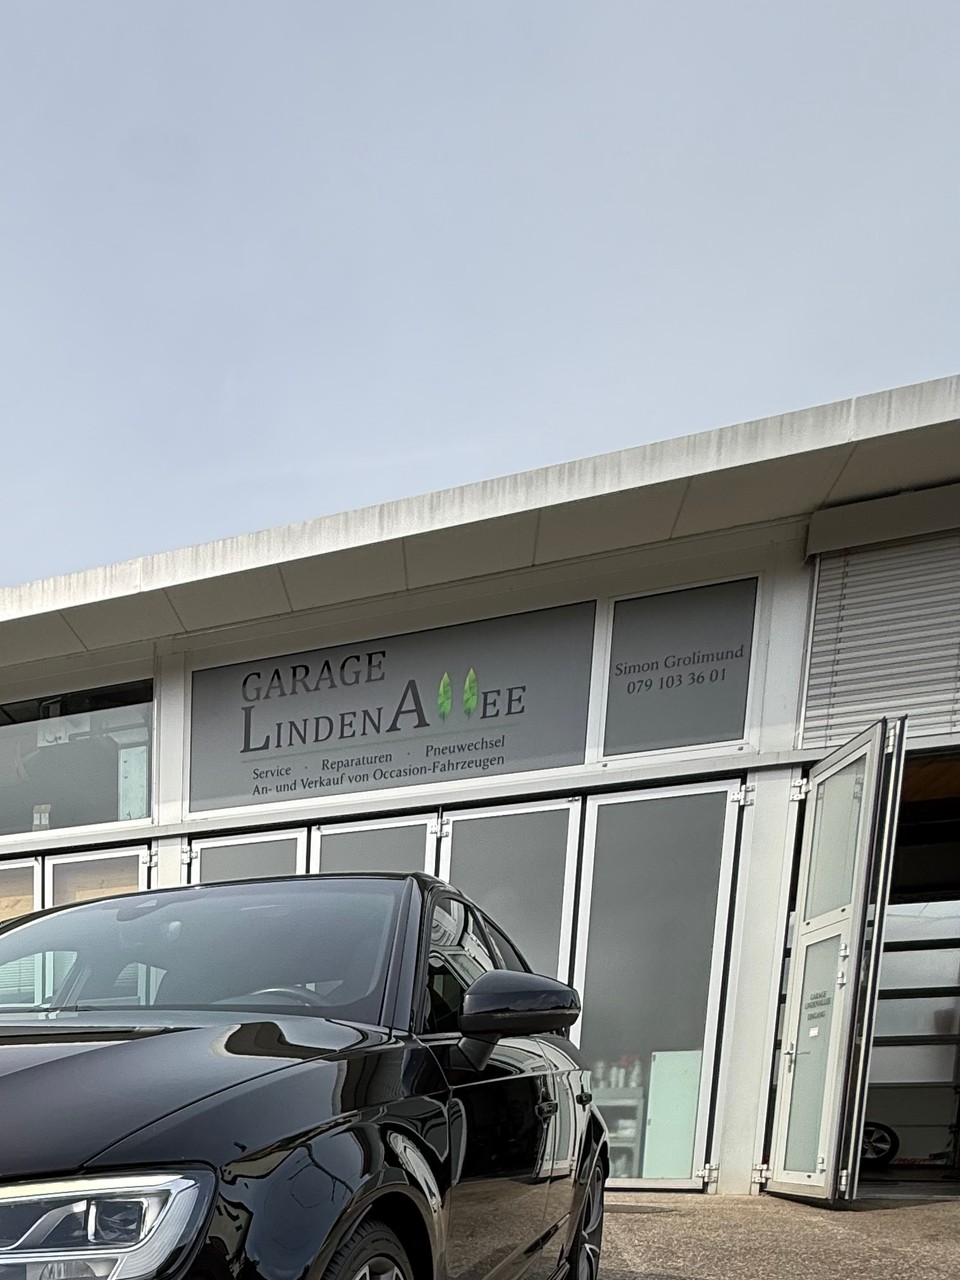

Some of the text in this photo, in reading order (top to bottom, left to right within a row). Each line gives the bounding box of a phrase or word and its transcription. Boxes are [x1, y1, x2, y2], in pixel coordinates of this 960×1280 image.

[241, 650, 386, 702] GARAGE
[614, 645, 744, 676] Simon Grolimund
[627, 668, 726, 694] 079 103 36 01
[252, 735, 505, 780] Service Reparaturen Pneuwechsel
[252, 755, 505, 796] An- und Verkauf von Occasion-Fahrzeugen
